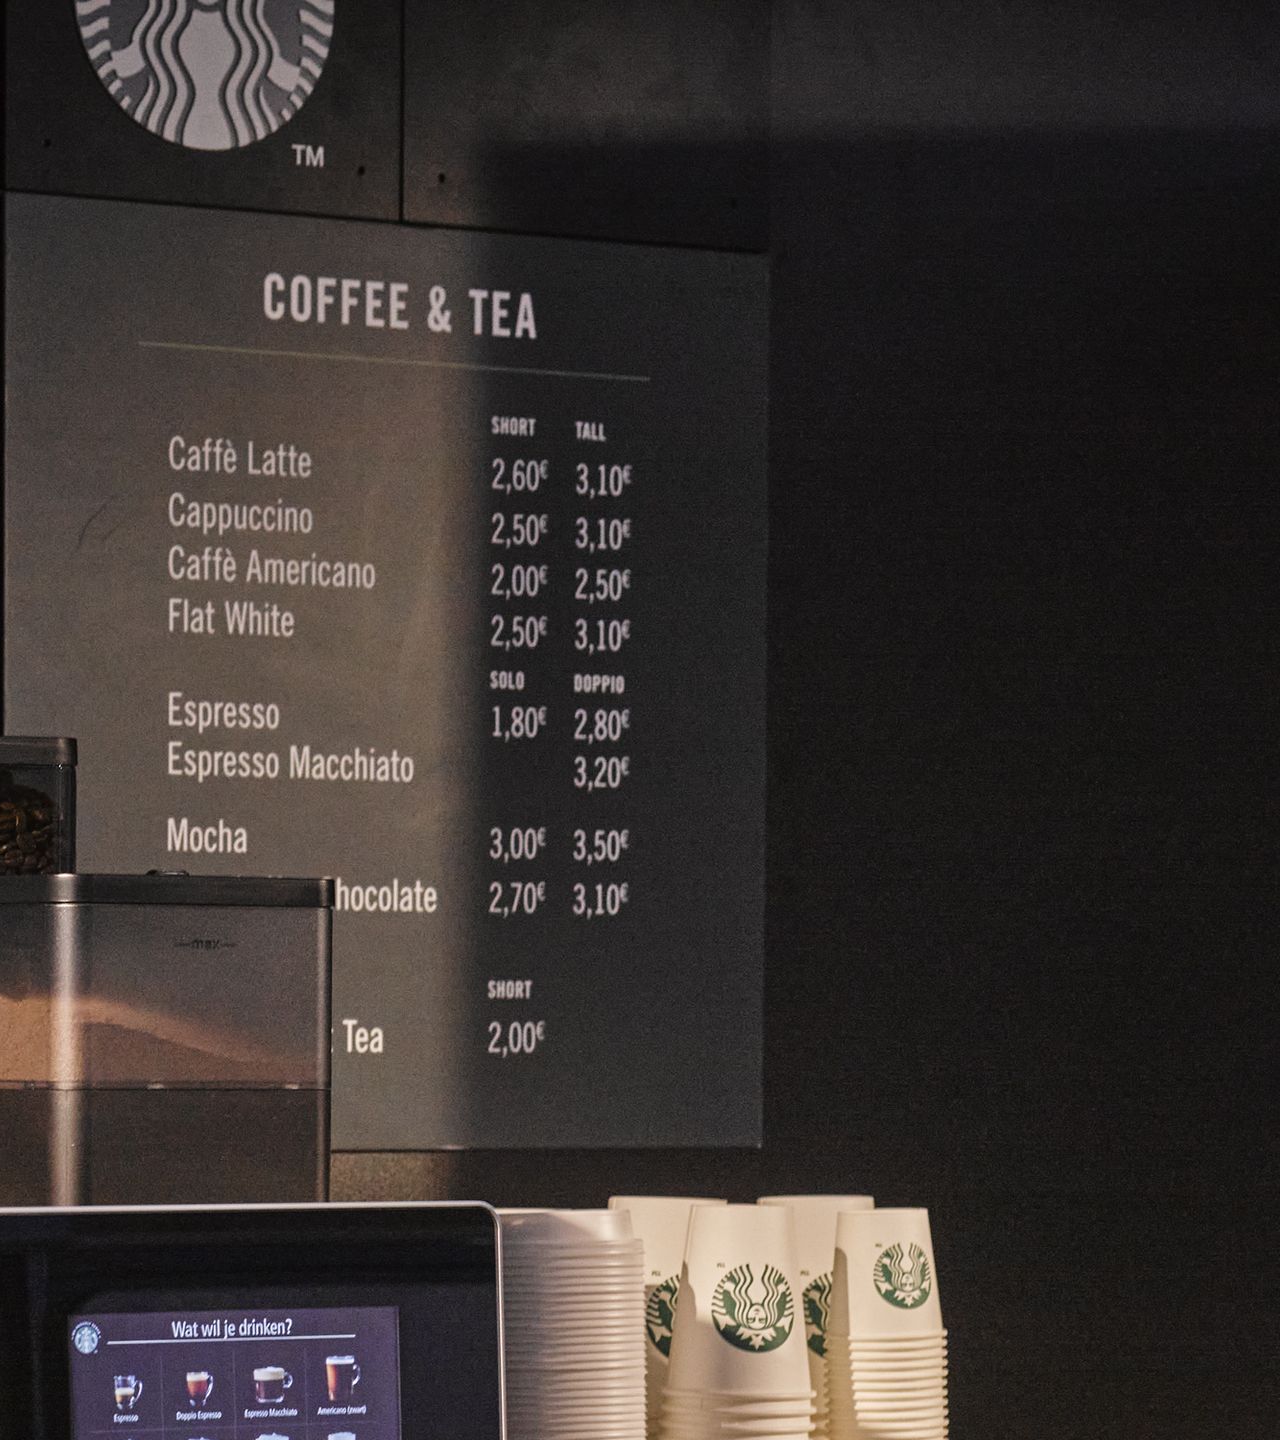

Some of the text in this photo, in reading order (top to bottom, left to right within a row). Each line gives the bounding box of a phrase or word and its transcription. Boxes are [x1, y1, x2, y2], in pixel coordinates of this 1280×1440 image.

[292, 144, 324, 168] TM
[264, 272, 538, 339] COFFEE & TEA
[491, 416, 606, 442] SHORT TALL
[168, 436, 312, 478] Caffè Latte
[491, 459, 632, 499] 2,60€ 3,10€
[168, 492, 314, 538] Cappuccino
[491, 512, 632, 552] 2,50€ 3,10€
[168, 546, 376, 590] Caffè Americano
[491, 564, 631, 604] 2,00€ 2,50€
[168, 598, 295, 638] Flat White
[491, 615, 631, 654] 2,50€ 3,10€
[490, 671, 625, 694] SOLO DOPPIO
[168, 692, 281, 732] Espresso
[491, 706, 630, 742] 1,80€ 2,80€
[168, 742, 415, 782] Espresso Macchiato
[573, 756, 630, 789] 3,20€
[167, 818, 248, 855] Mocha
[489, 828, 629, 864] 3,00€ 3,50€
[335, 879, 438, 913] hocolate
[489, 882, 629, 918] 2,70€ 3,10€
[488, 980, 532, 999] SHORT
[342, 1019, 384, 1053] Tea
[488, 1021, 545, 1055] 2,00€
[172, 1319, 293, 1339] Wat wil je drinken?
[114, 1413, 138, 1422] Espresso
[176, 1410, 222, 1420] Doppio Espresso
[244, 1408, 297, 1418] Espresso Macchiato
